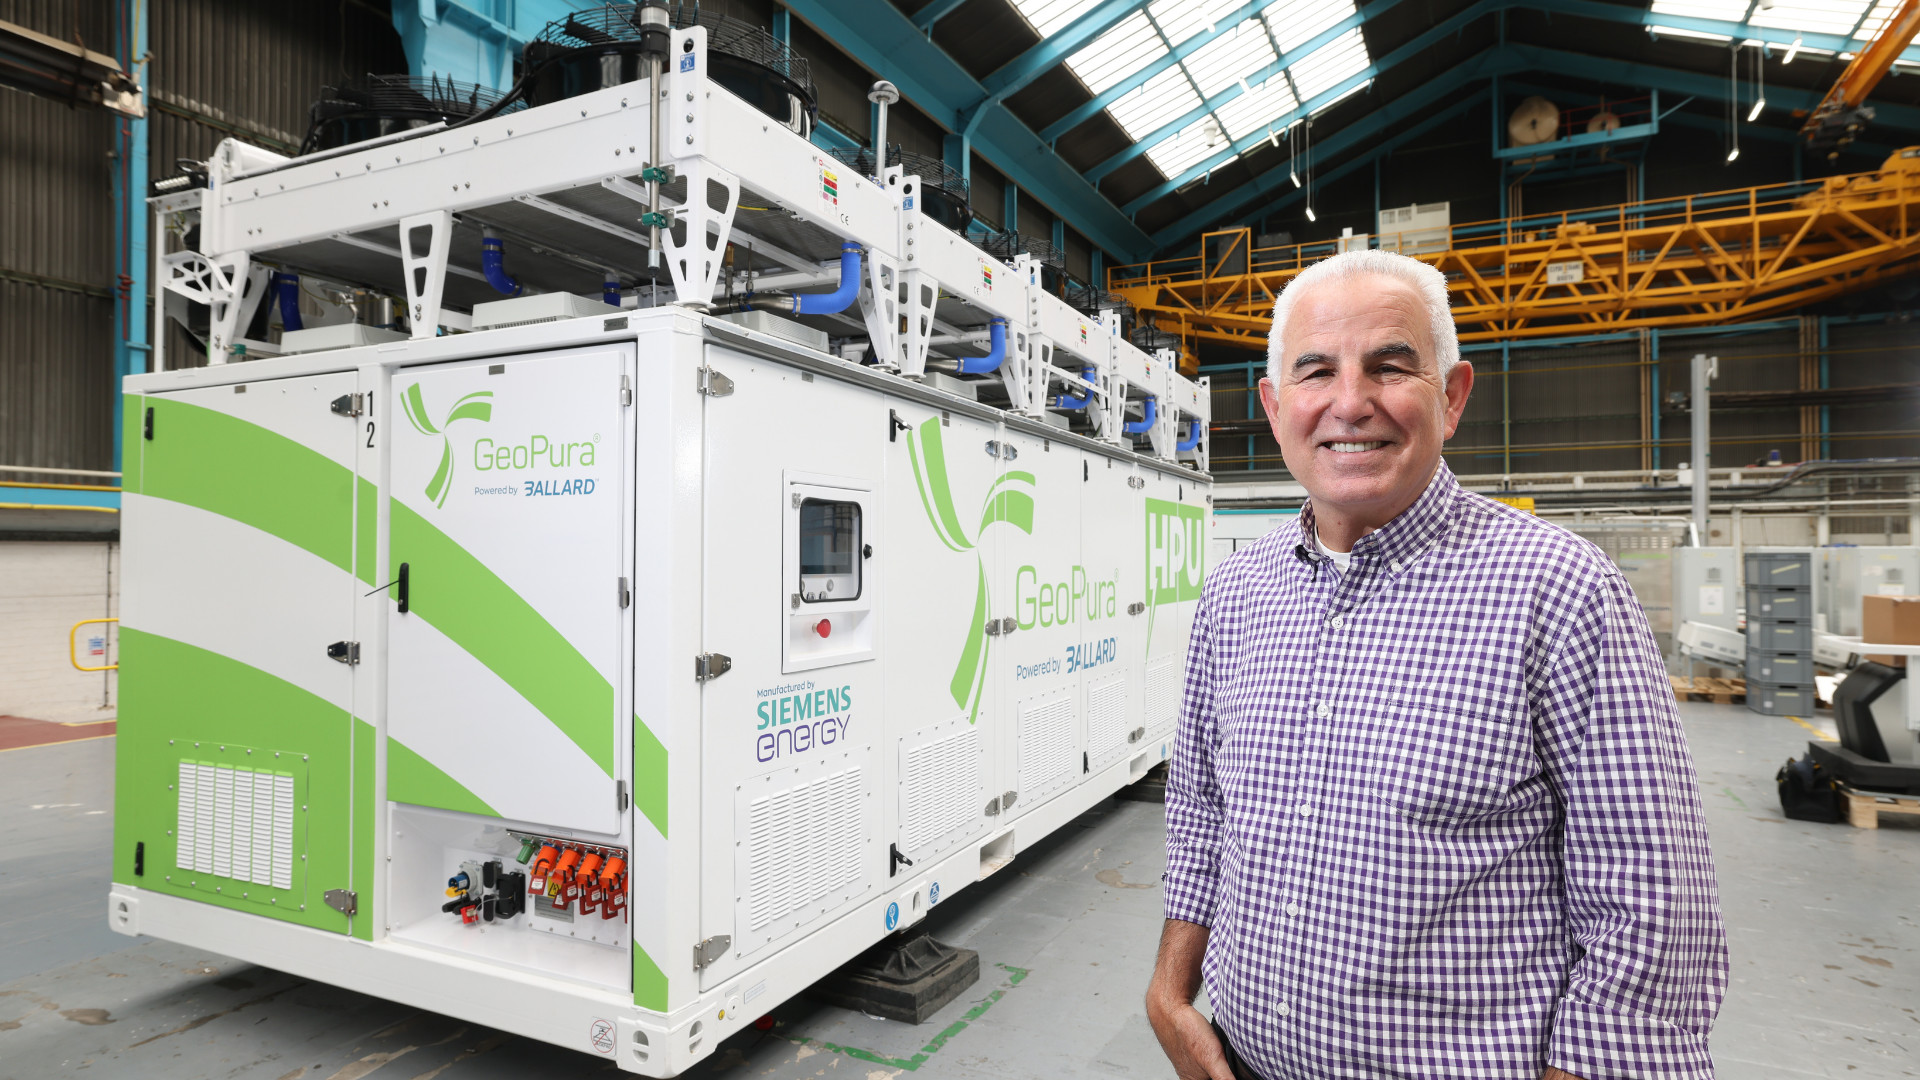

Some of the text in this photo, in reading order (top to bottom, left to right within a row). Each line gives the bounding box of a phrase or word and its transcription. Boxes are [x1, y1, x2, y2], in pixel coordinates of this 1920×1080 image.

[474, 486, 507, 495] Powered
[508, 485, 518, 496] by
[1149, 512, 1202, 591] HPU
[1016, 657, 1051, 681] Powered
[1052, 656, 1061, 675] by
[757, 680, 815, 698] Manufactured by
[757, 685, 852, 731] SIEMENS
